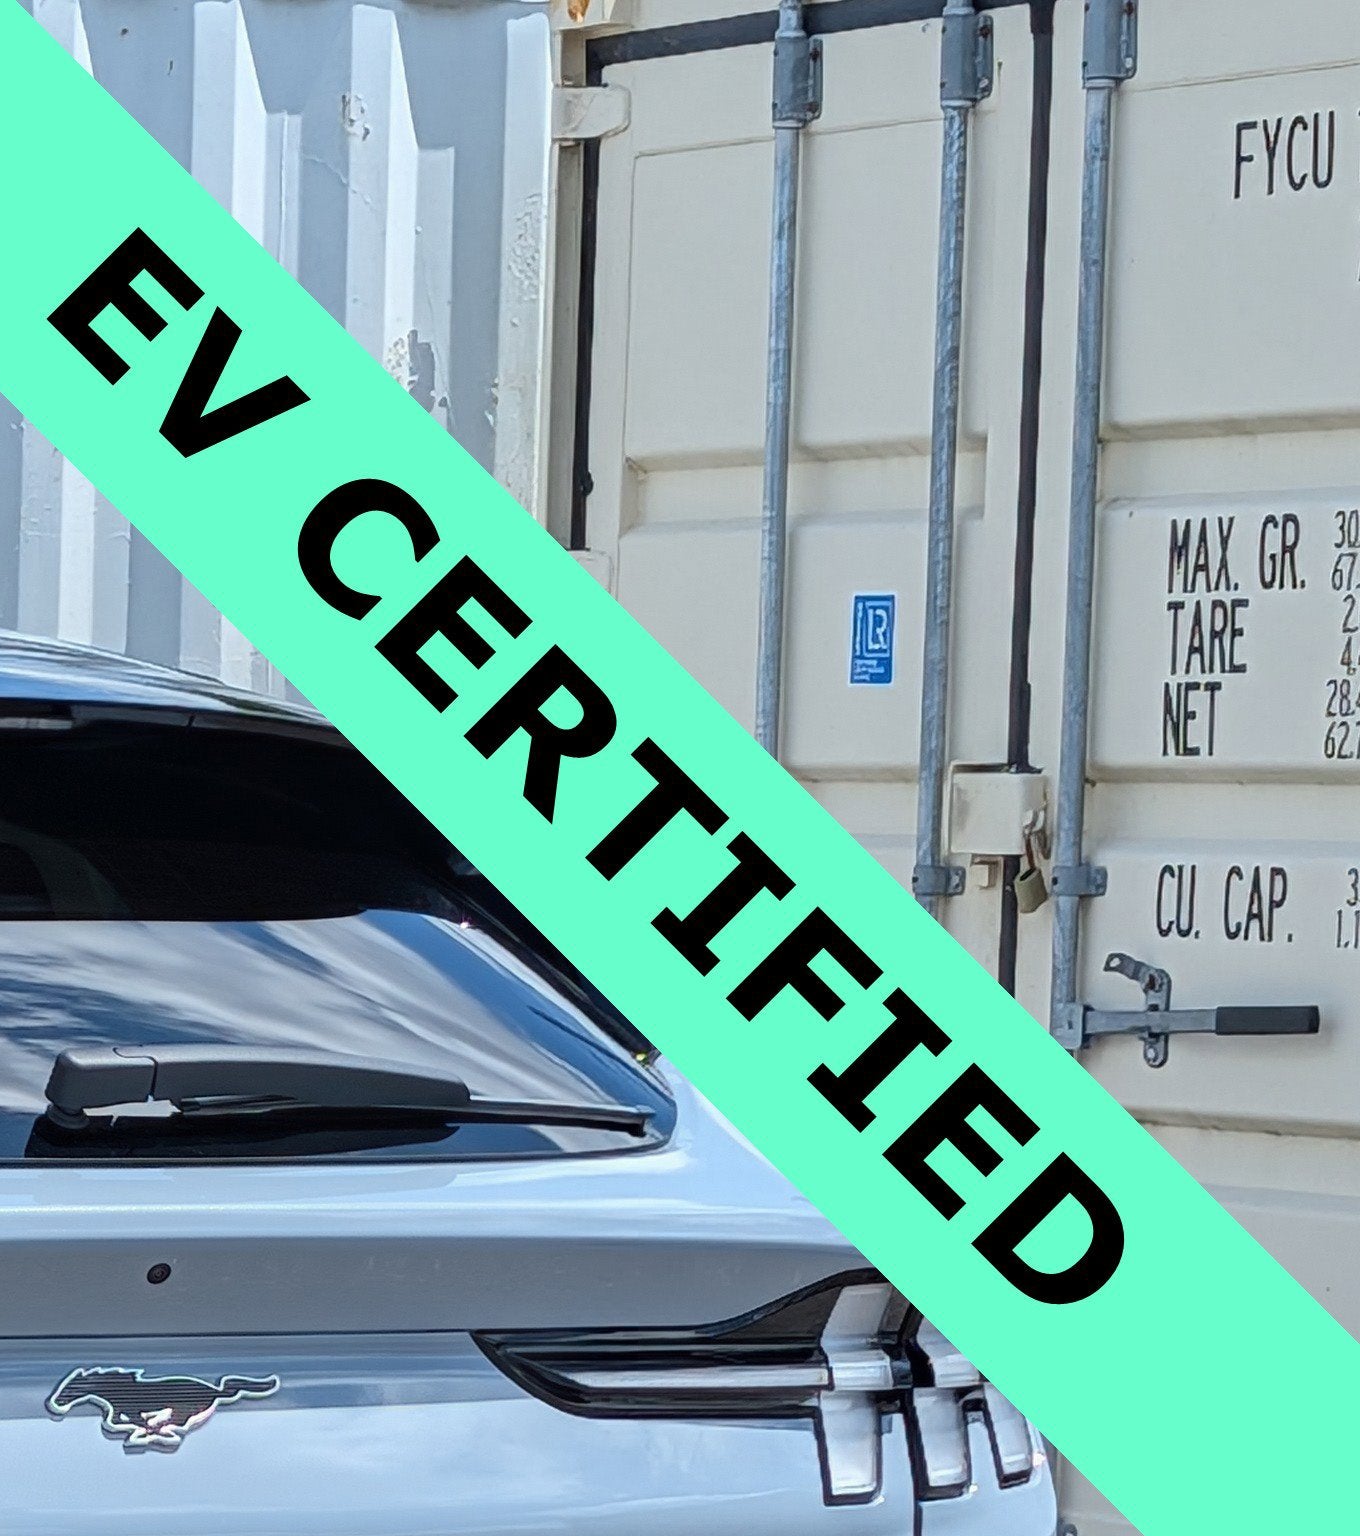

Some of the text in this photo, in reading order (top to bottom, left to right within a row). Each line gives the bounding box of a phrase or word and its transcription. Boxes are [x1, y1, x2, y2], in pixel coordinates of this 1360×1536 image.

[1234, 110, 1335, 199] FYCU
[1168, 513, 1306, 593] MAX. GR.
[1167, 598, 1249, 675] TARE
[1163, 681, 1222, 757] NET
[1156, 864, 1293, 942] CU. CAP.
